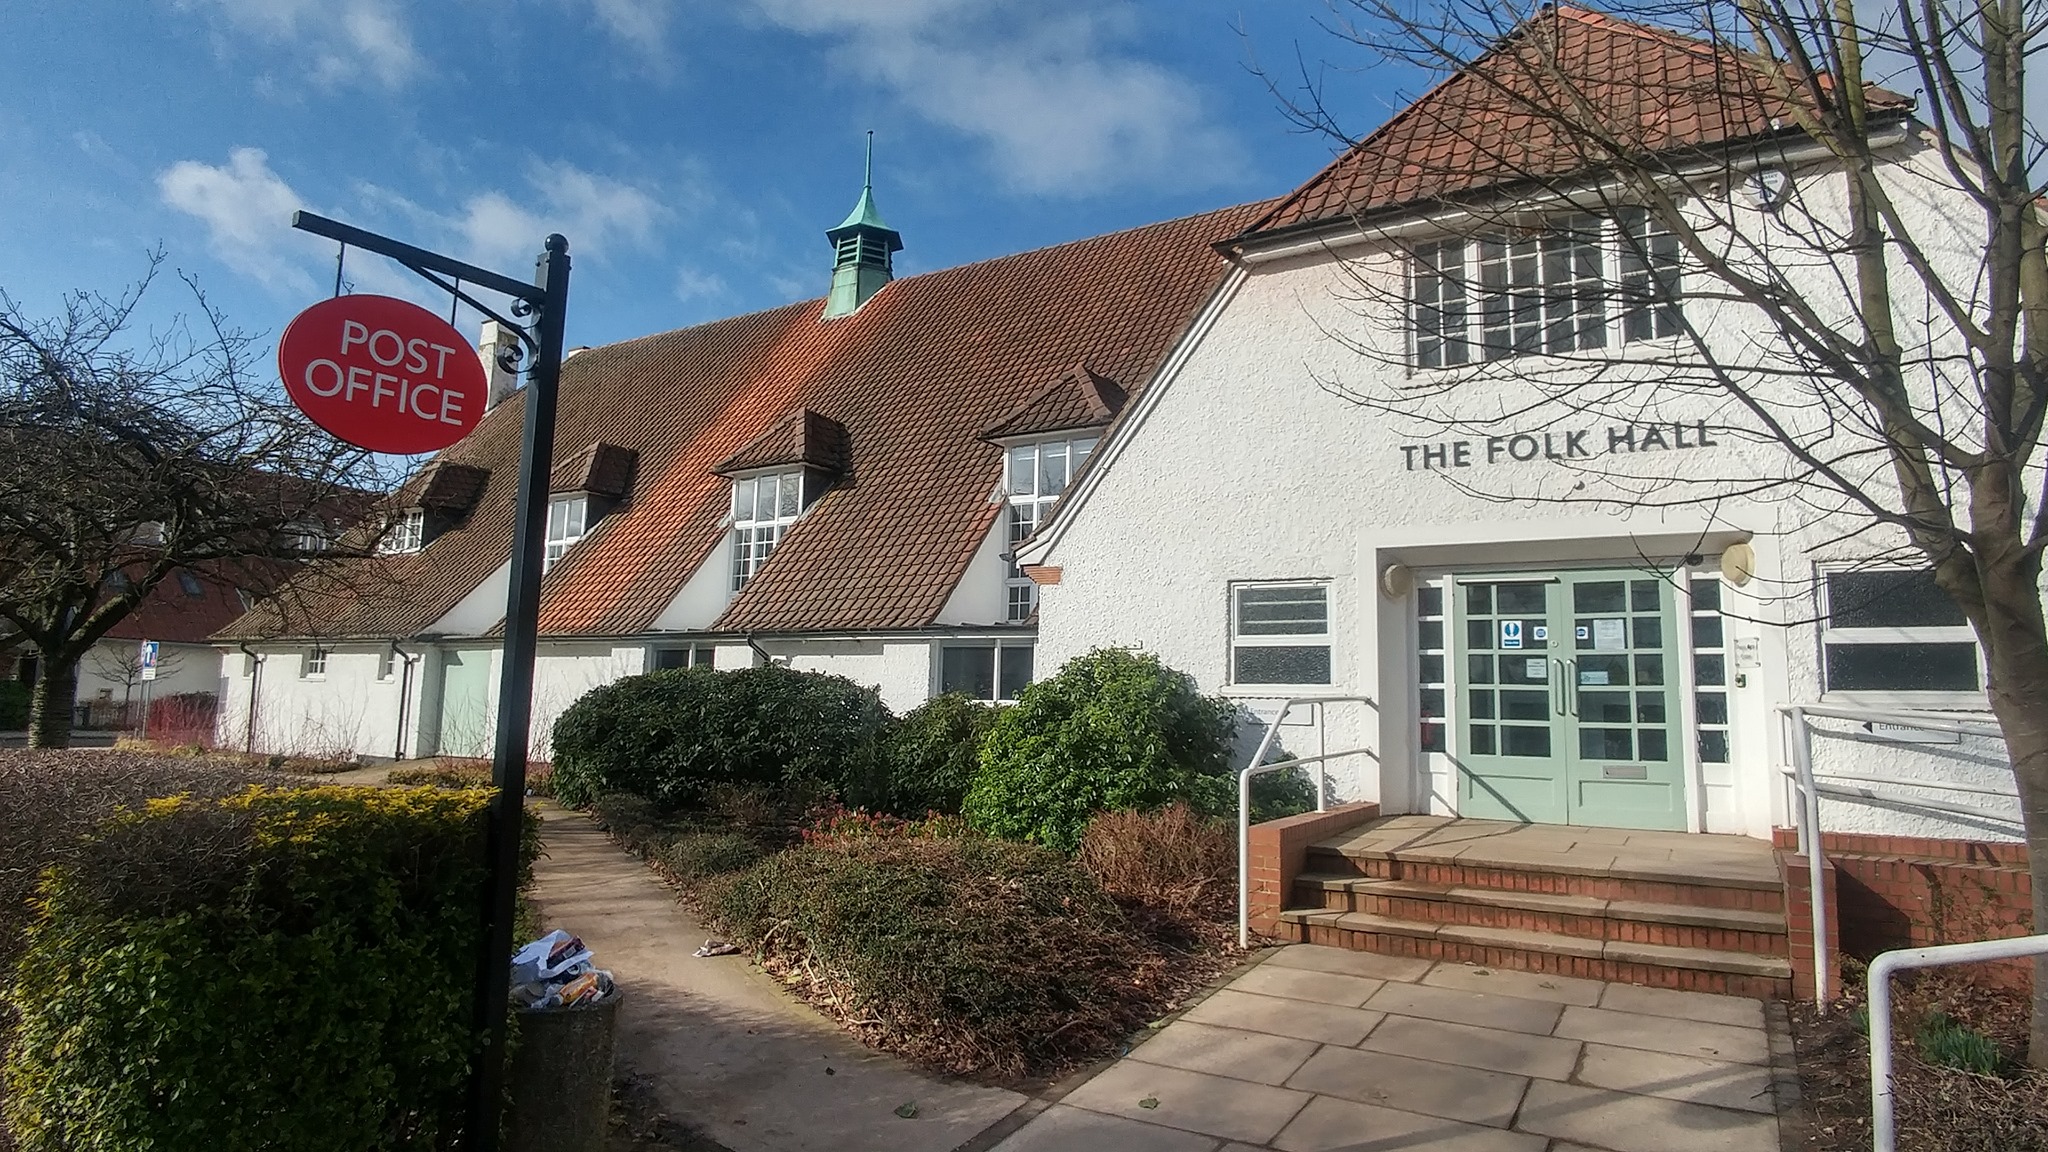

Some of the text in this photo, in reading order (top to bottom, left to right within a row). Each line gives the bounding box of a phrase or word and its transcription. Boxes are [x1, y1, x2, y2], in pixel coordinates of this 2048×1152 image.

[340, 319, 456, 379] POST
[304, 358, 465, 426] OFFICE
[1400, 419, 1718, 471] THE FOLK HALL
